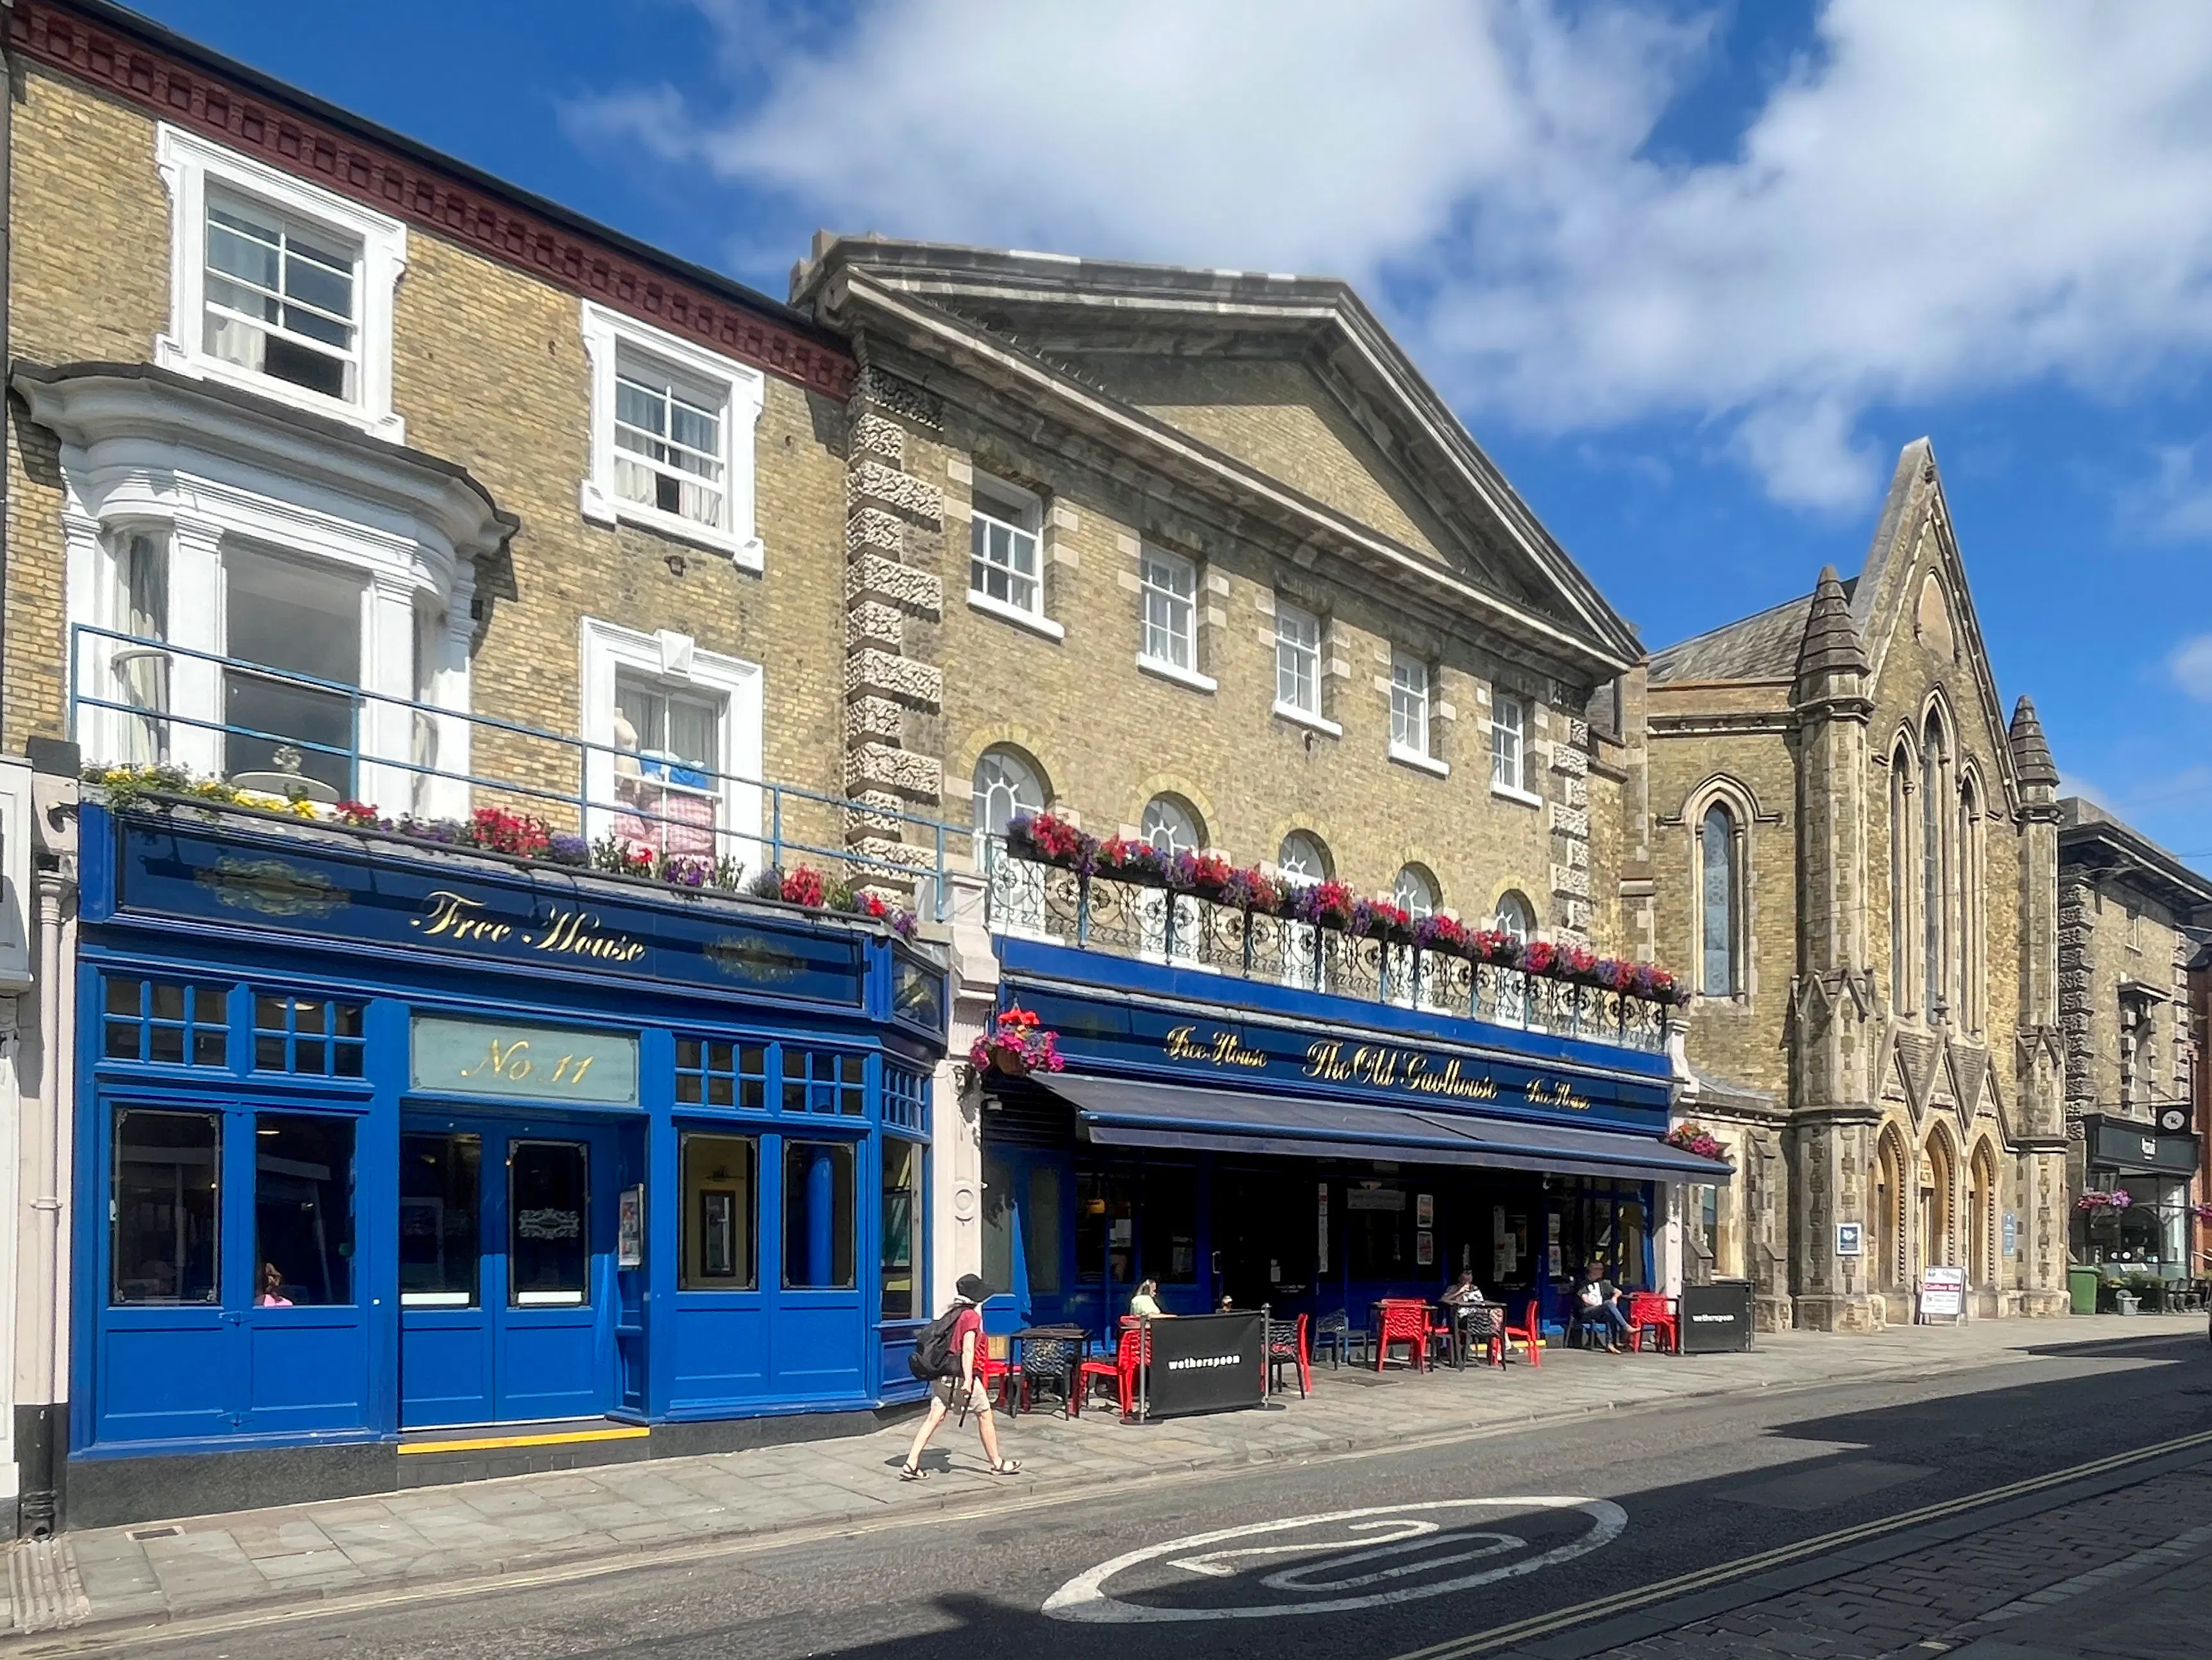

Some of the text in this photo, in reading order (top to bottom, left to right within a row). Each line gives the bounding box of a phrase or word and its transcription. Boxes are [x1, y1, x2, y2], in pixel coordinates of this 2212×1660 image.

[410, 891, 645, 961] Free House
[1163, 1025, 1268, 1067] Free House
[550, 1053, 594, 1084] 11
[1301, 1040, 1498, 1100] The Old Gaolhouse
[1692, 1314, 1735, 1323] wetherspoon
[1168, 1355, 1241, 1371] wetherspoon
[1166, 1518, 1527, 1592] 20
